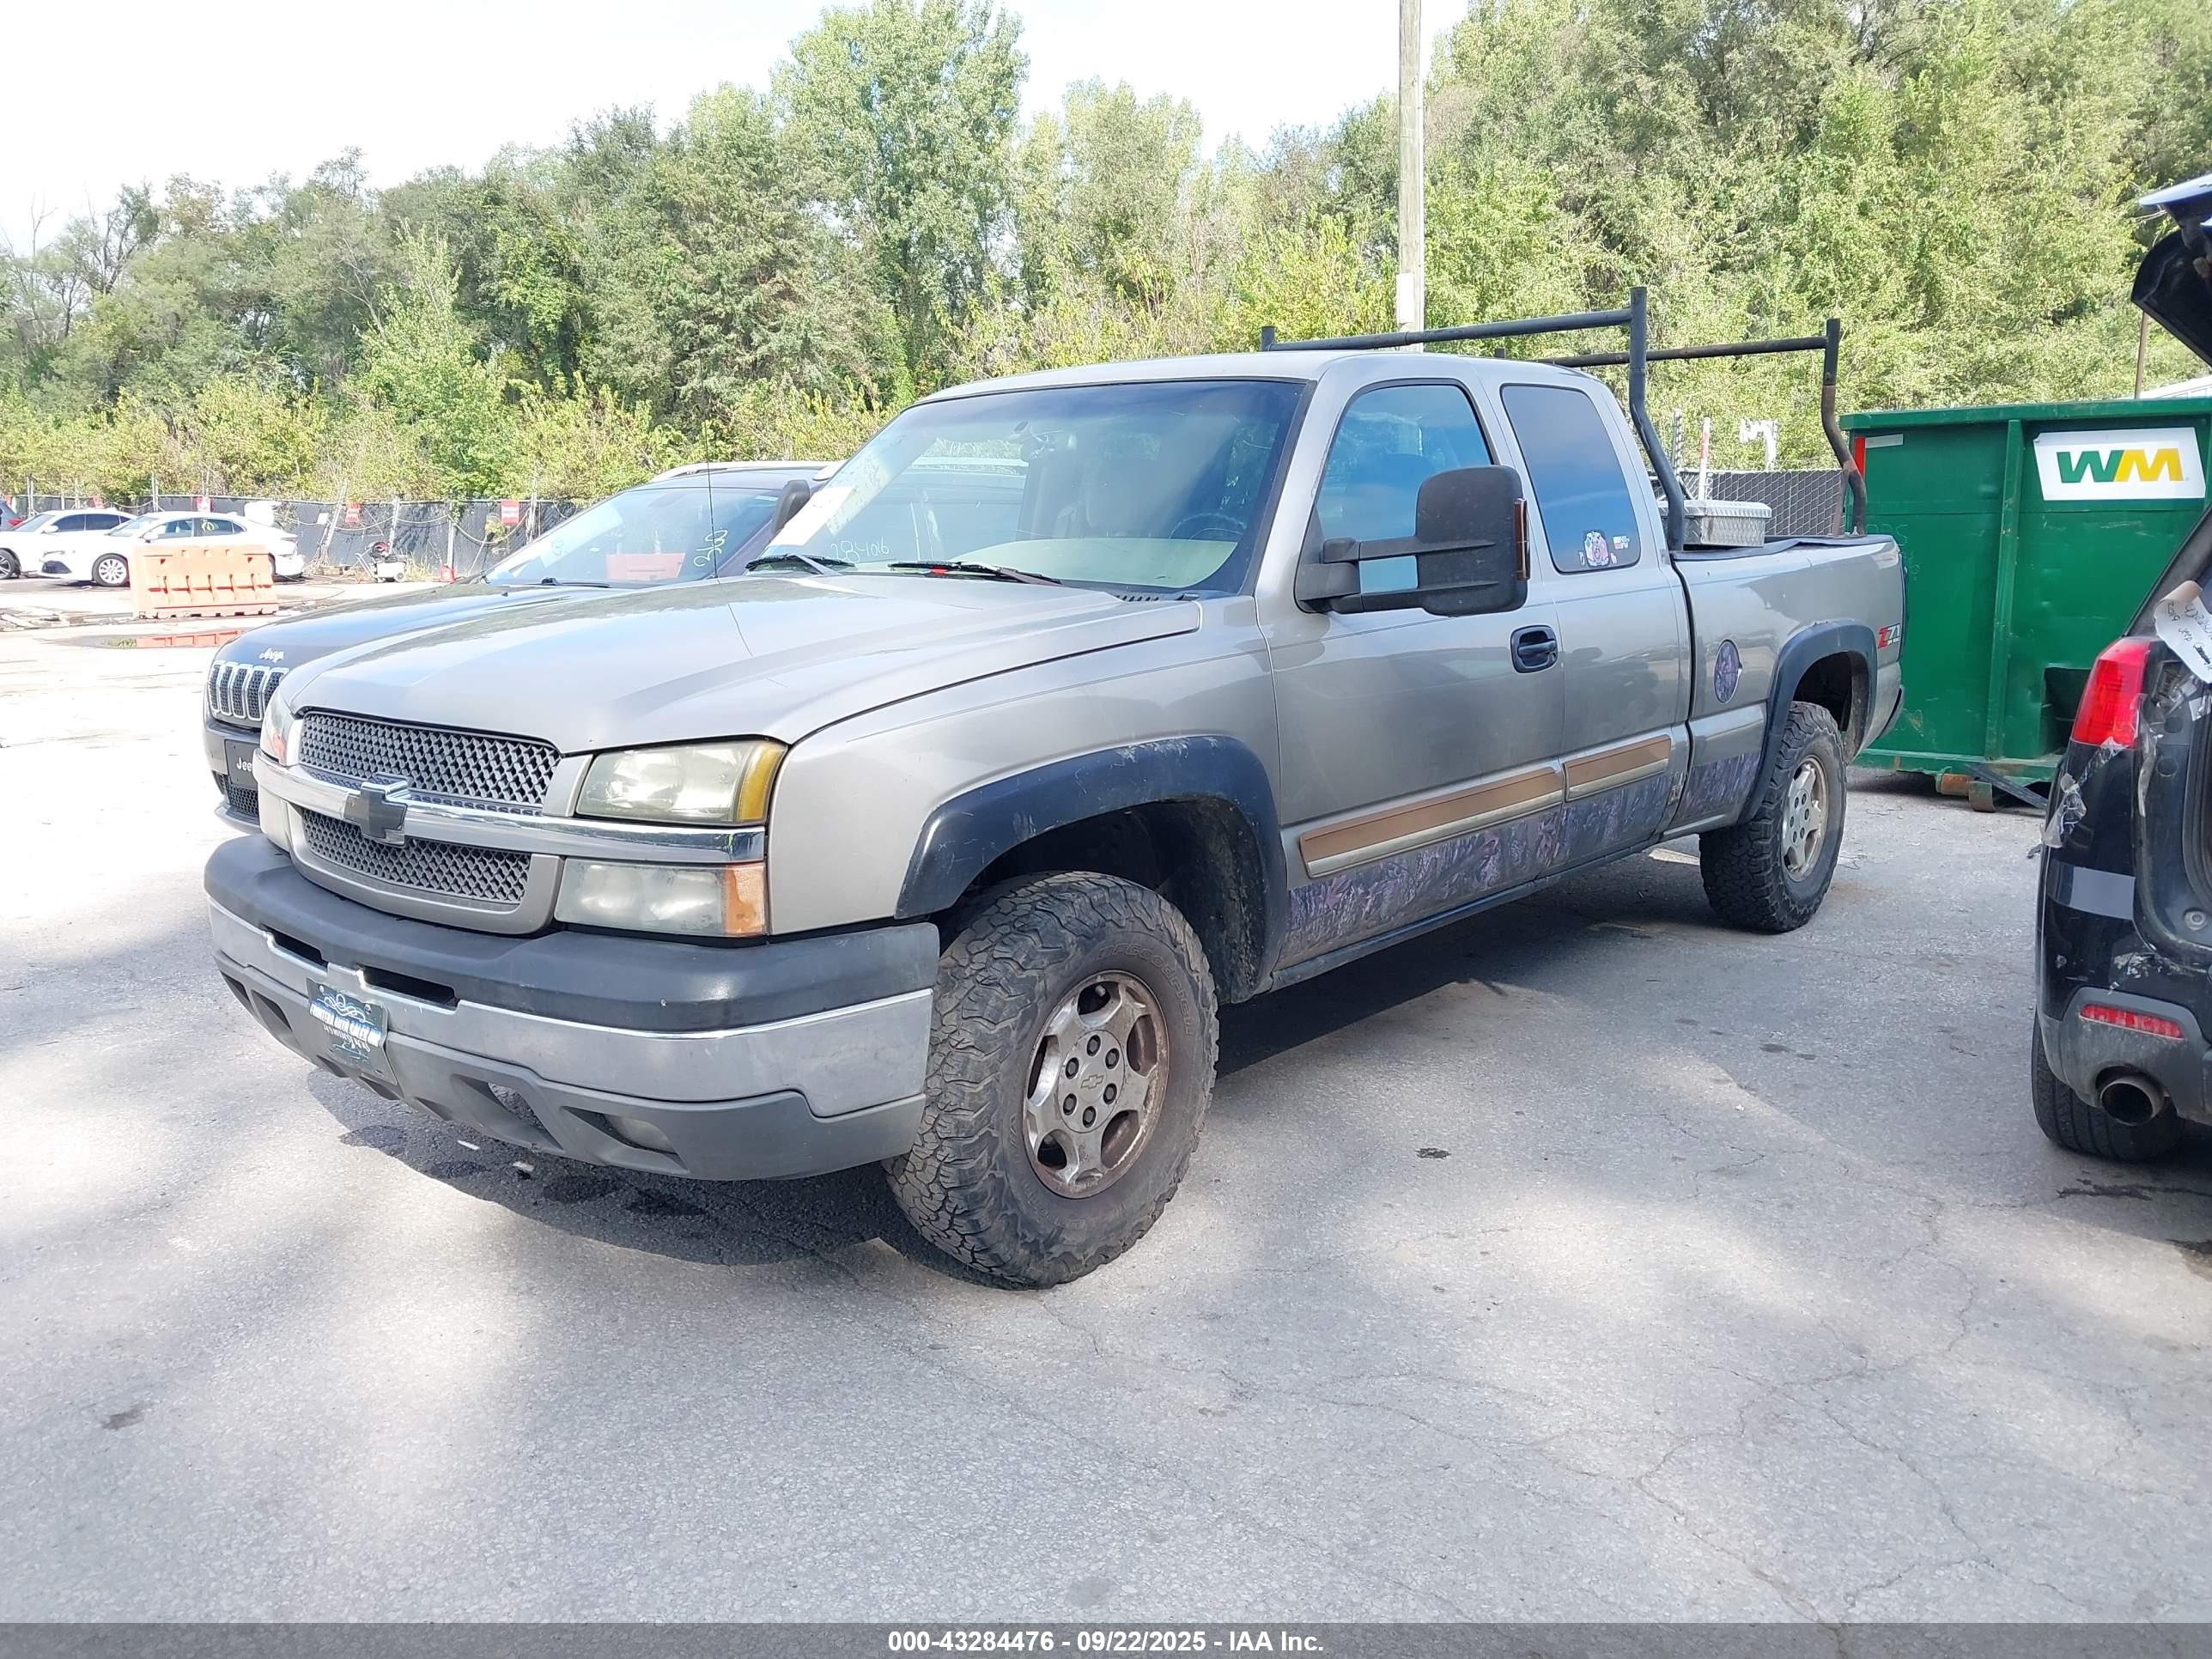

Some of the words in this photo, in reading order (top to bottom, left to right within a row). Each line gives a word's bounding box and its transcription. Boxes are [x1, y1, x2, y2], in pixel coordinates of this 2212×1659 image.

[2056, 447, 2184, 483] WM
[1878, 624, 1901, 647] Z71
[235, 757, 253, 772] Jee
